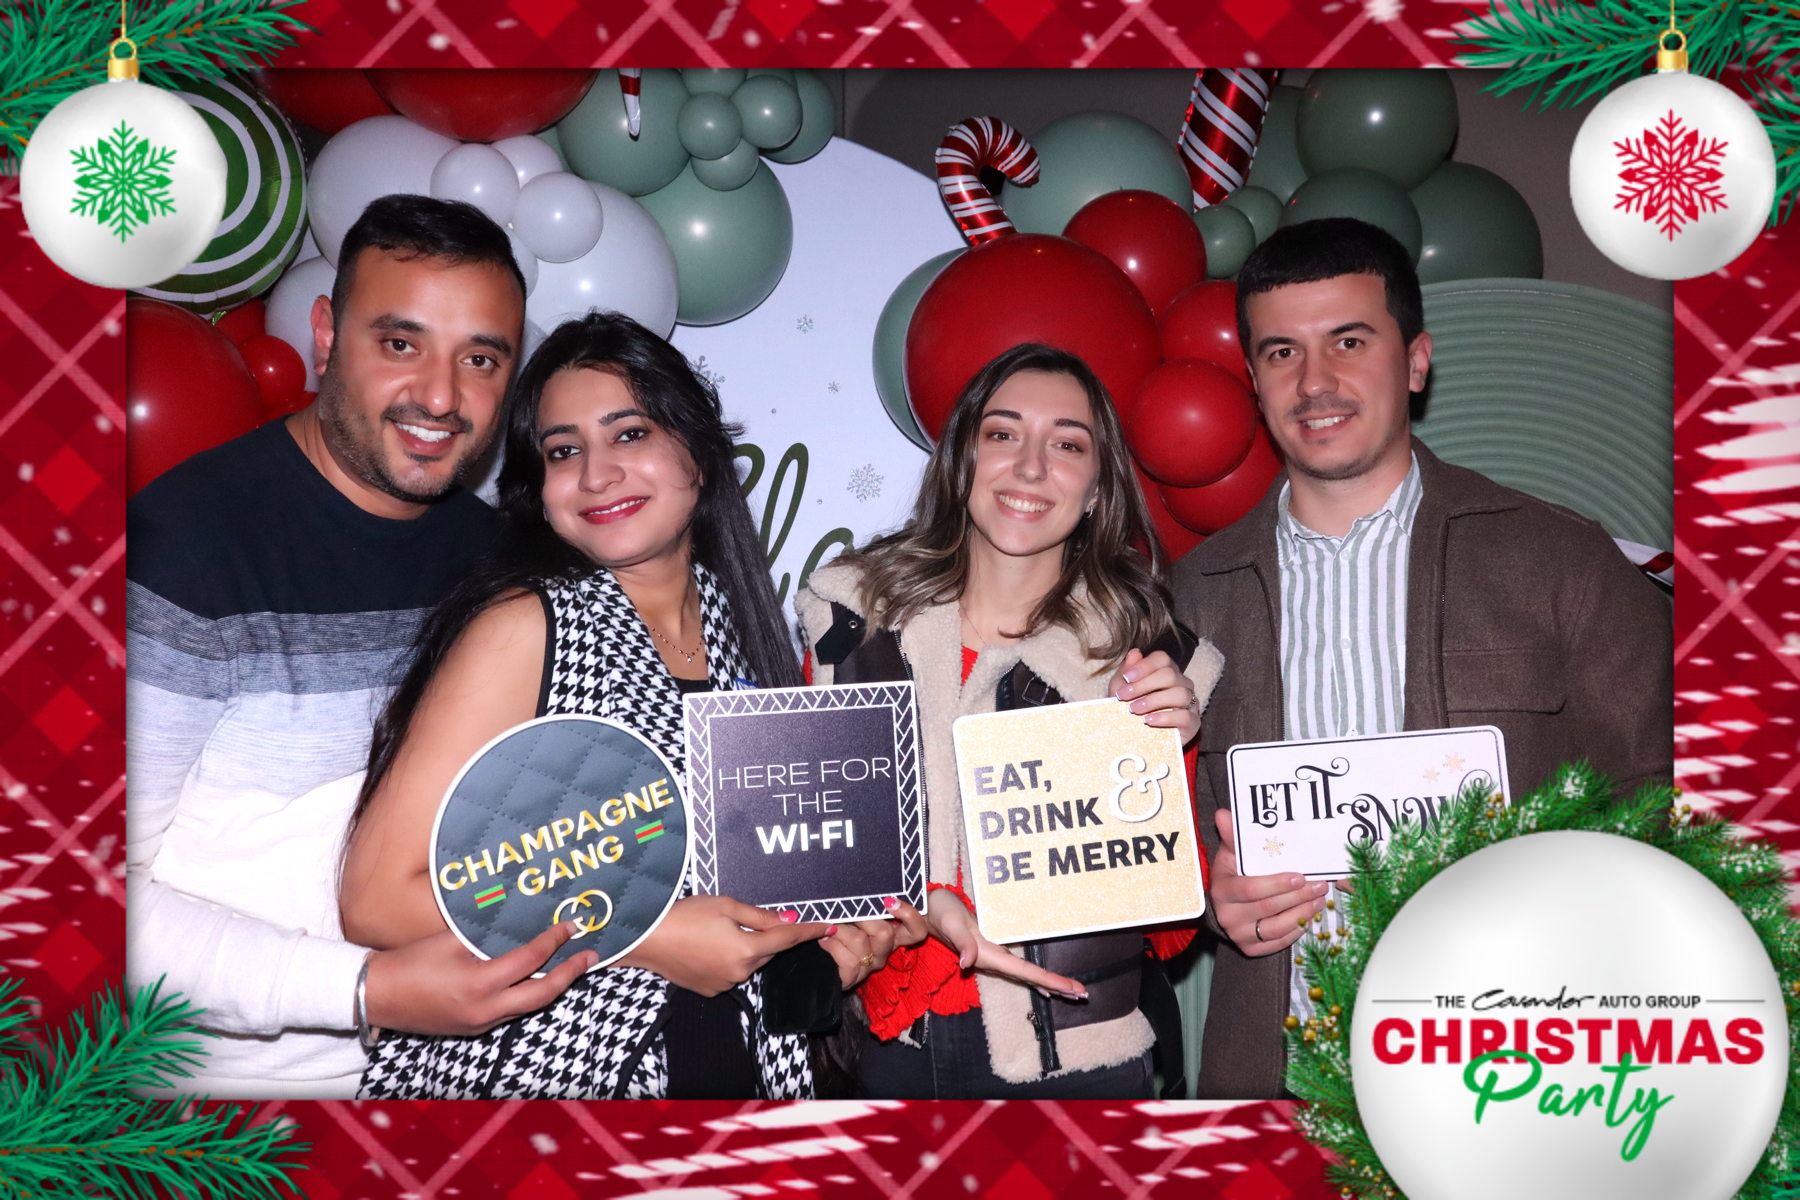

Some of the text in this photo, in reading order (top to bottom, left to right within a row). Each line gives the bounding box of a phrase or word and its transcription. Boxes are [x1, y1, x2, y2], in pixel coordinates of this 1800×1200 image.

[718, 757, 891, 790] HERE FOR
[973, 759, 1052, 796] EAT,
[979, 753, 1170, 841] DRINK &
[1248, 756, 1351, 829] LET IT
[772, 790, 843, 816] THE
[439, 778, 675, 891] CHAMPAGNE
[755, 819, 854, 855] WI-FI
[985, 831, 1180, 886] BE MERRY
[517, 835, 624, 896] GANG
